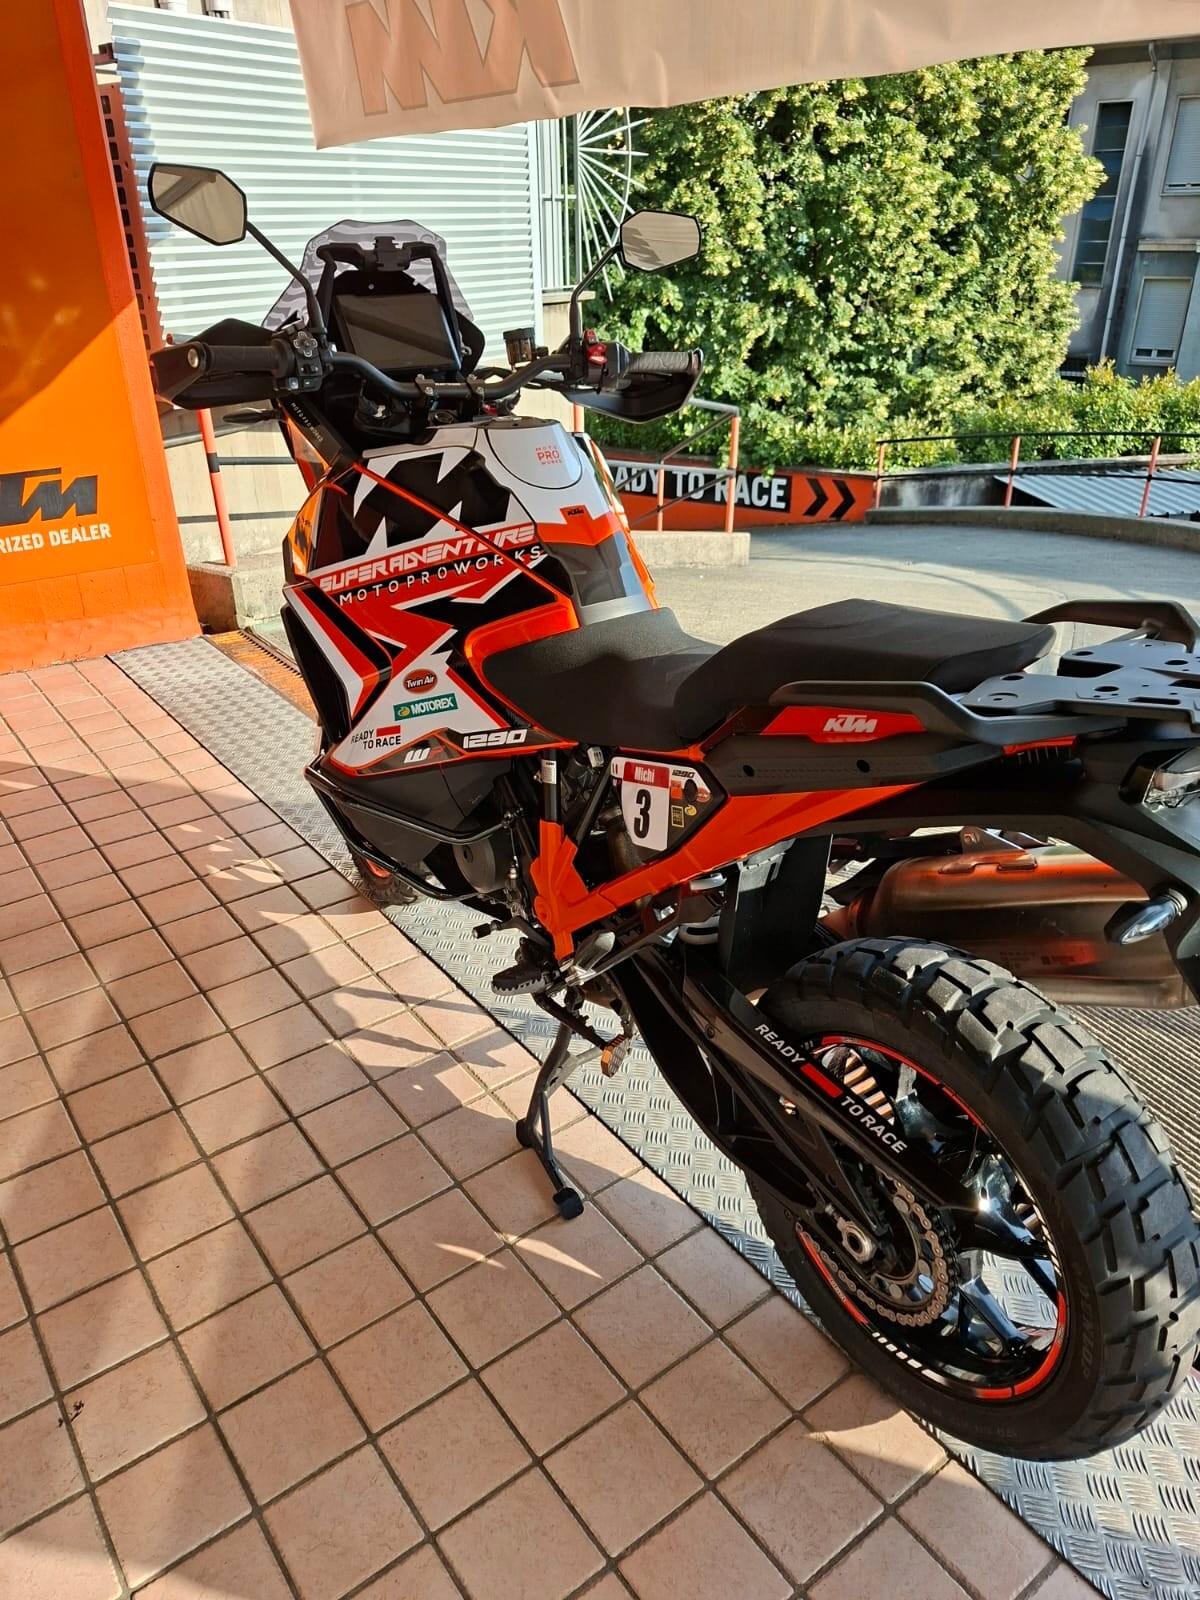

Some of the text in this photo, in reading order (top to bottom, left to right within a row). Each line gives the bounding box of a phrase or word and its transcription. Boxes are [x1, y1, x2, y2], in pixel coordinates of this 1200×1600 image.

[537, 450, 560, 462] PRO
[672, 469, 704, 500] TO
[714, 473, 788, 509] RACE
[48, 523, 112, 547] DEALER
[407, 675, 434, 689] Twin Air
[410, 697, 455, 716] MOTOREX
[823, 714, 878, 733] KTM
[351, 729, 374, 745] READY
[363, 735, 401, 750] TO RACE
[463, 729, 527, 749] 1290
[634, 766, 655, 783] Michi
[634, 788, 652, 839] 3
[754, 1023, 908, 1155] READY TO RACE
